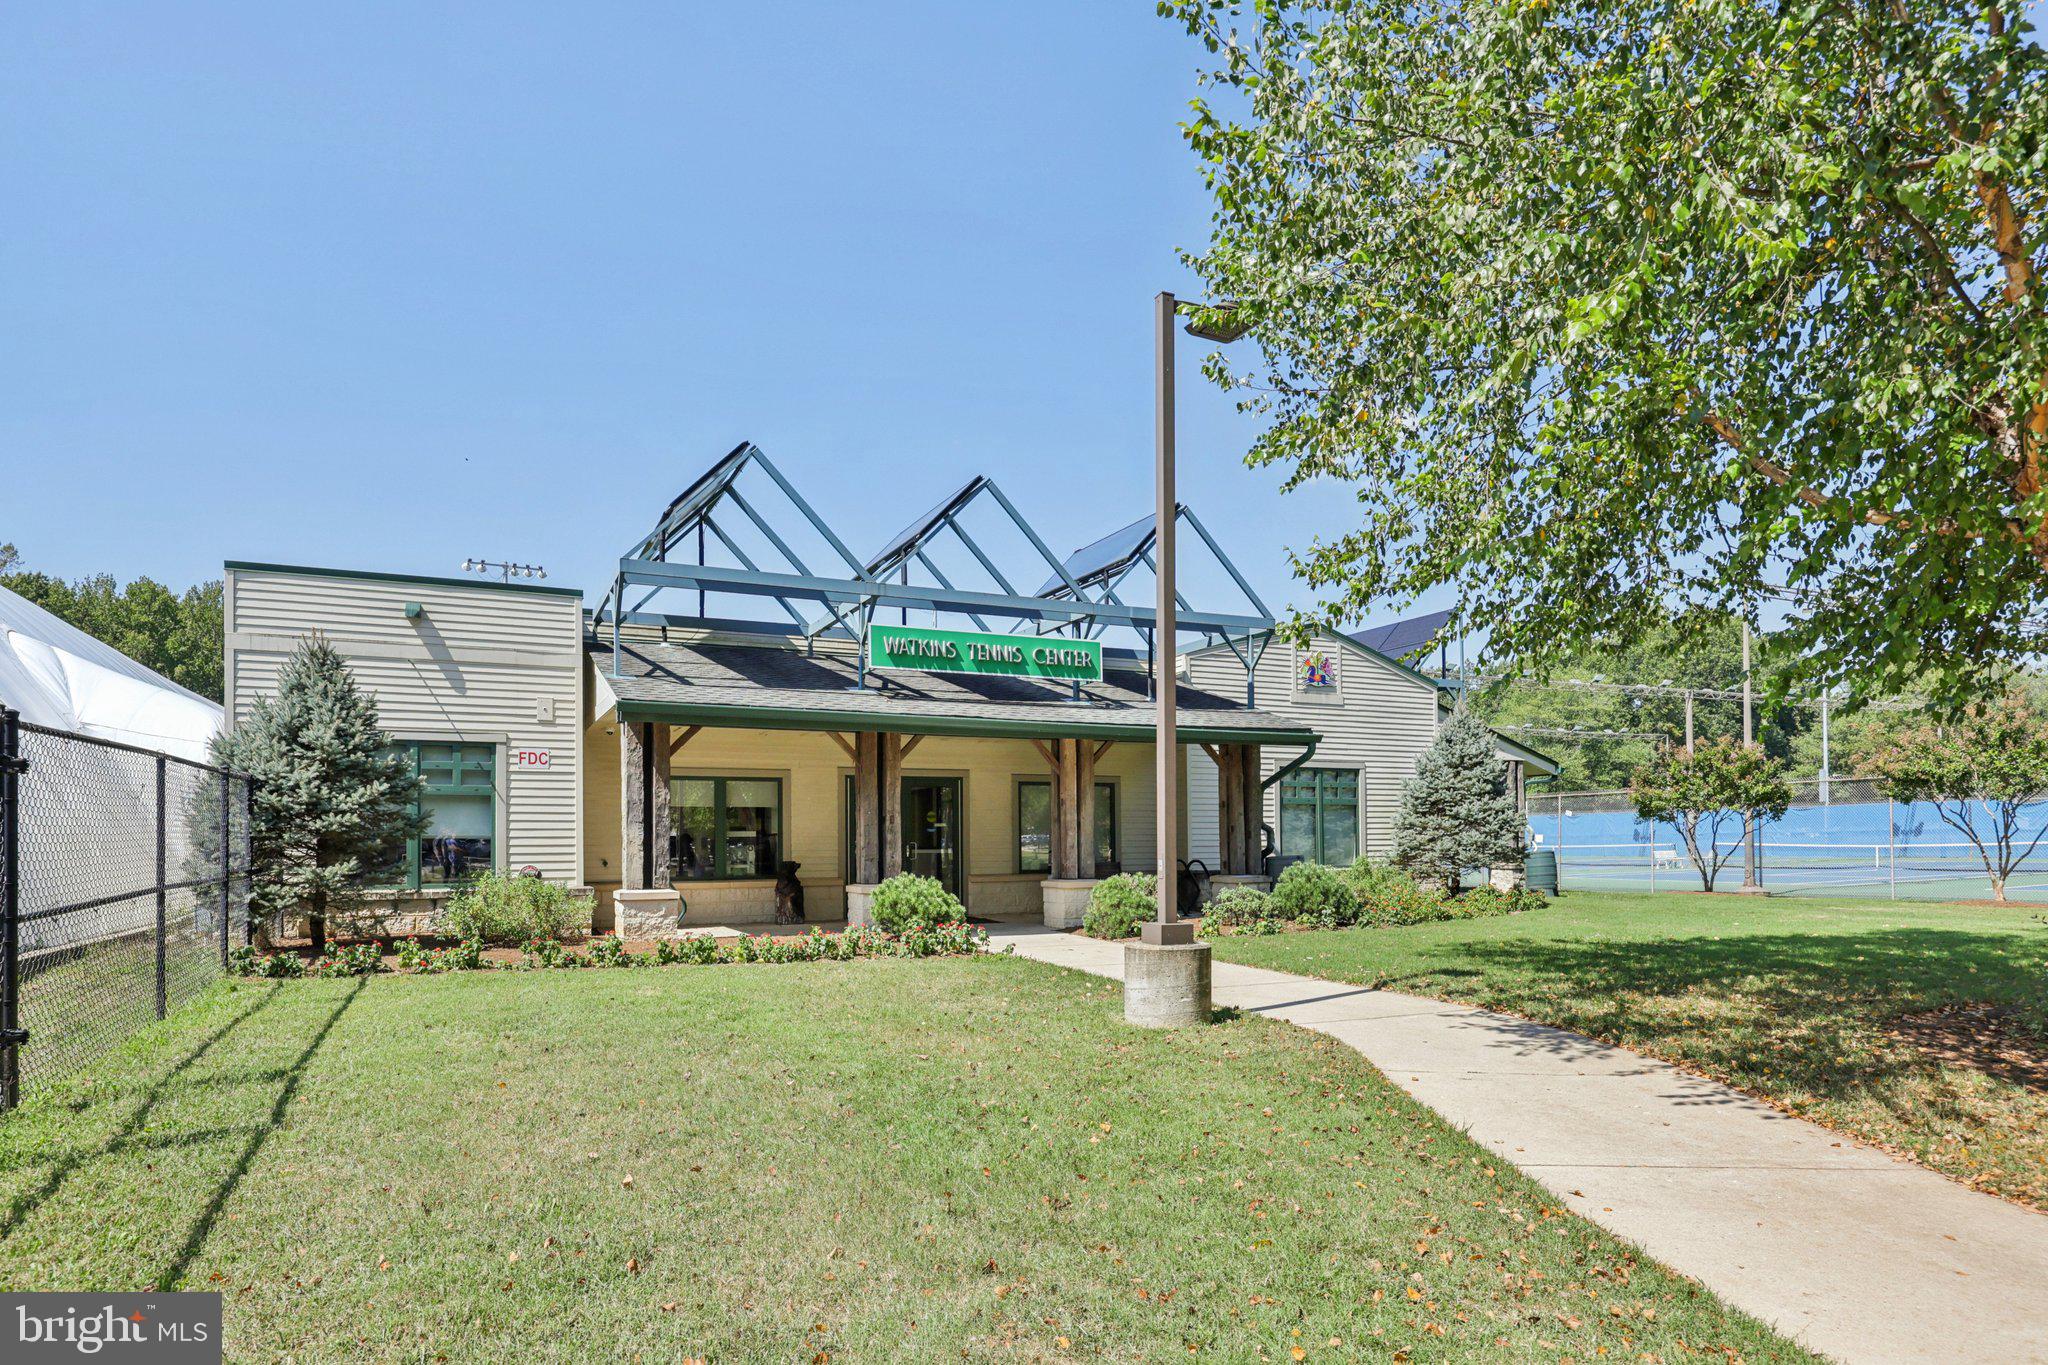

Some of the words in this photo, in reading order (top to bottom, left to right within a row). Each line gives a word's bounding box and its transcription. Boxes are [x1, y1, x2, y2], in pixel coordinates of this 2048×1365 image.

[883, 635, 957, 659] WATKINS
[966, 642, 1023, 664] TENNIS
[1032, 648, 1092, 668] CENTER
[519, 751, 548, 765] FDC
